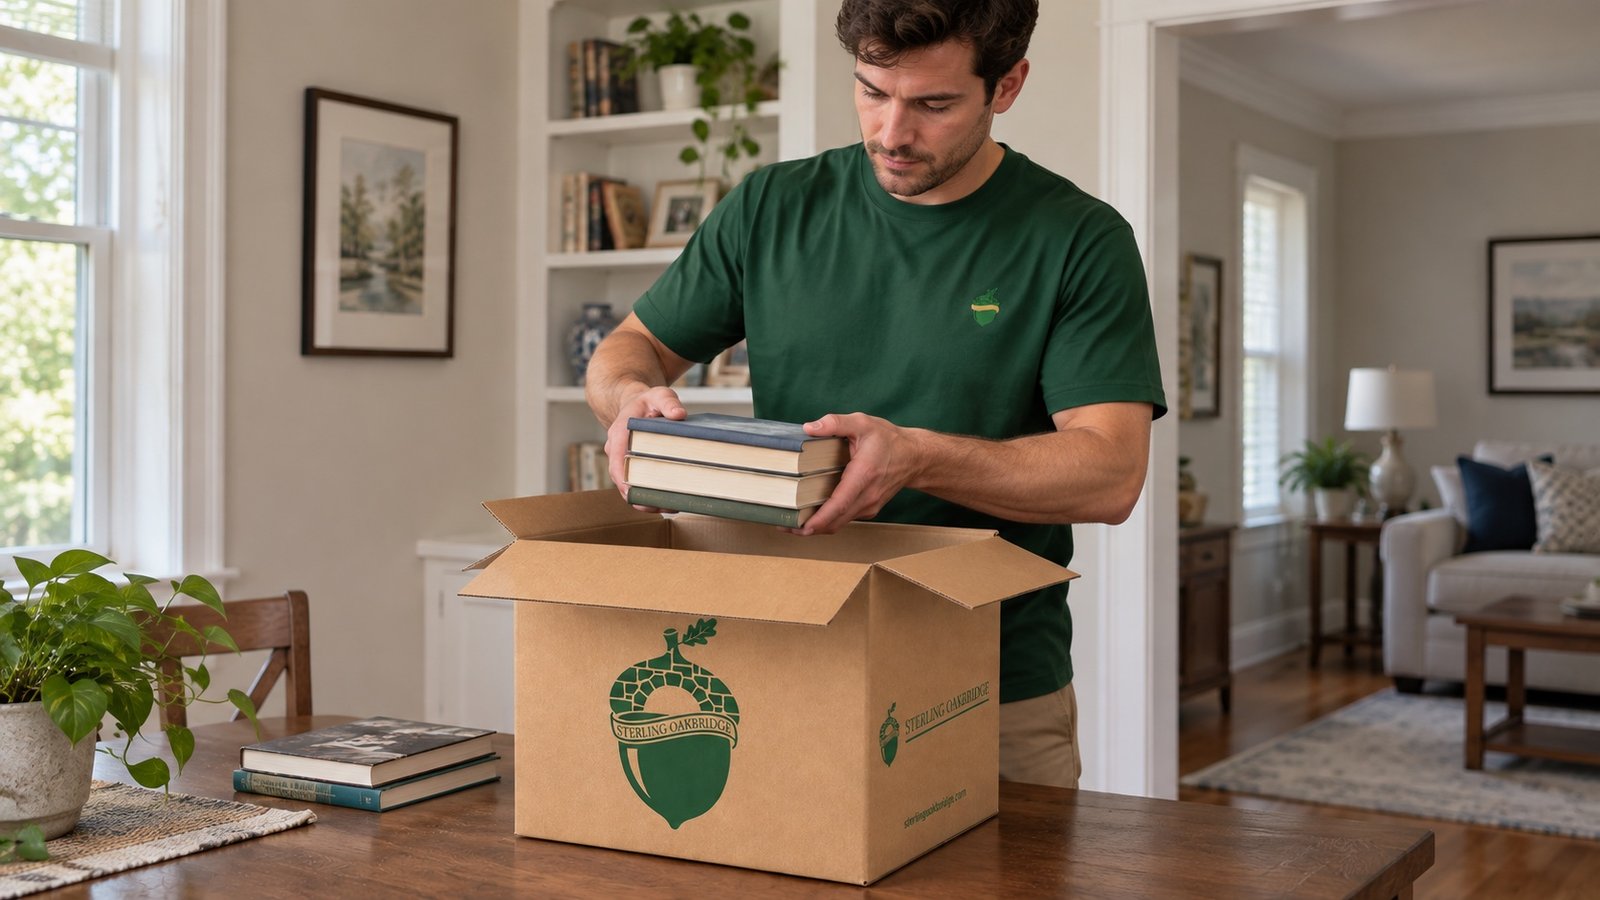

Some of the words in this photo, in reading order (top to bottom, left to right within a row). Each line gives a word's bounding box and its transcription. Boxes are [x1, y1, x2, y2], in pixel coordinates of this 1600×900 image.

[905, 702, 945, 735] STERLING
[946, 681, 990, 713] OAKBRIDGE
[616, 723, 667, 738] STERLING
[669, 717, 731, 734] OAKBRIDGE
